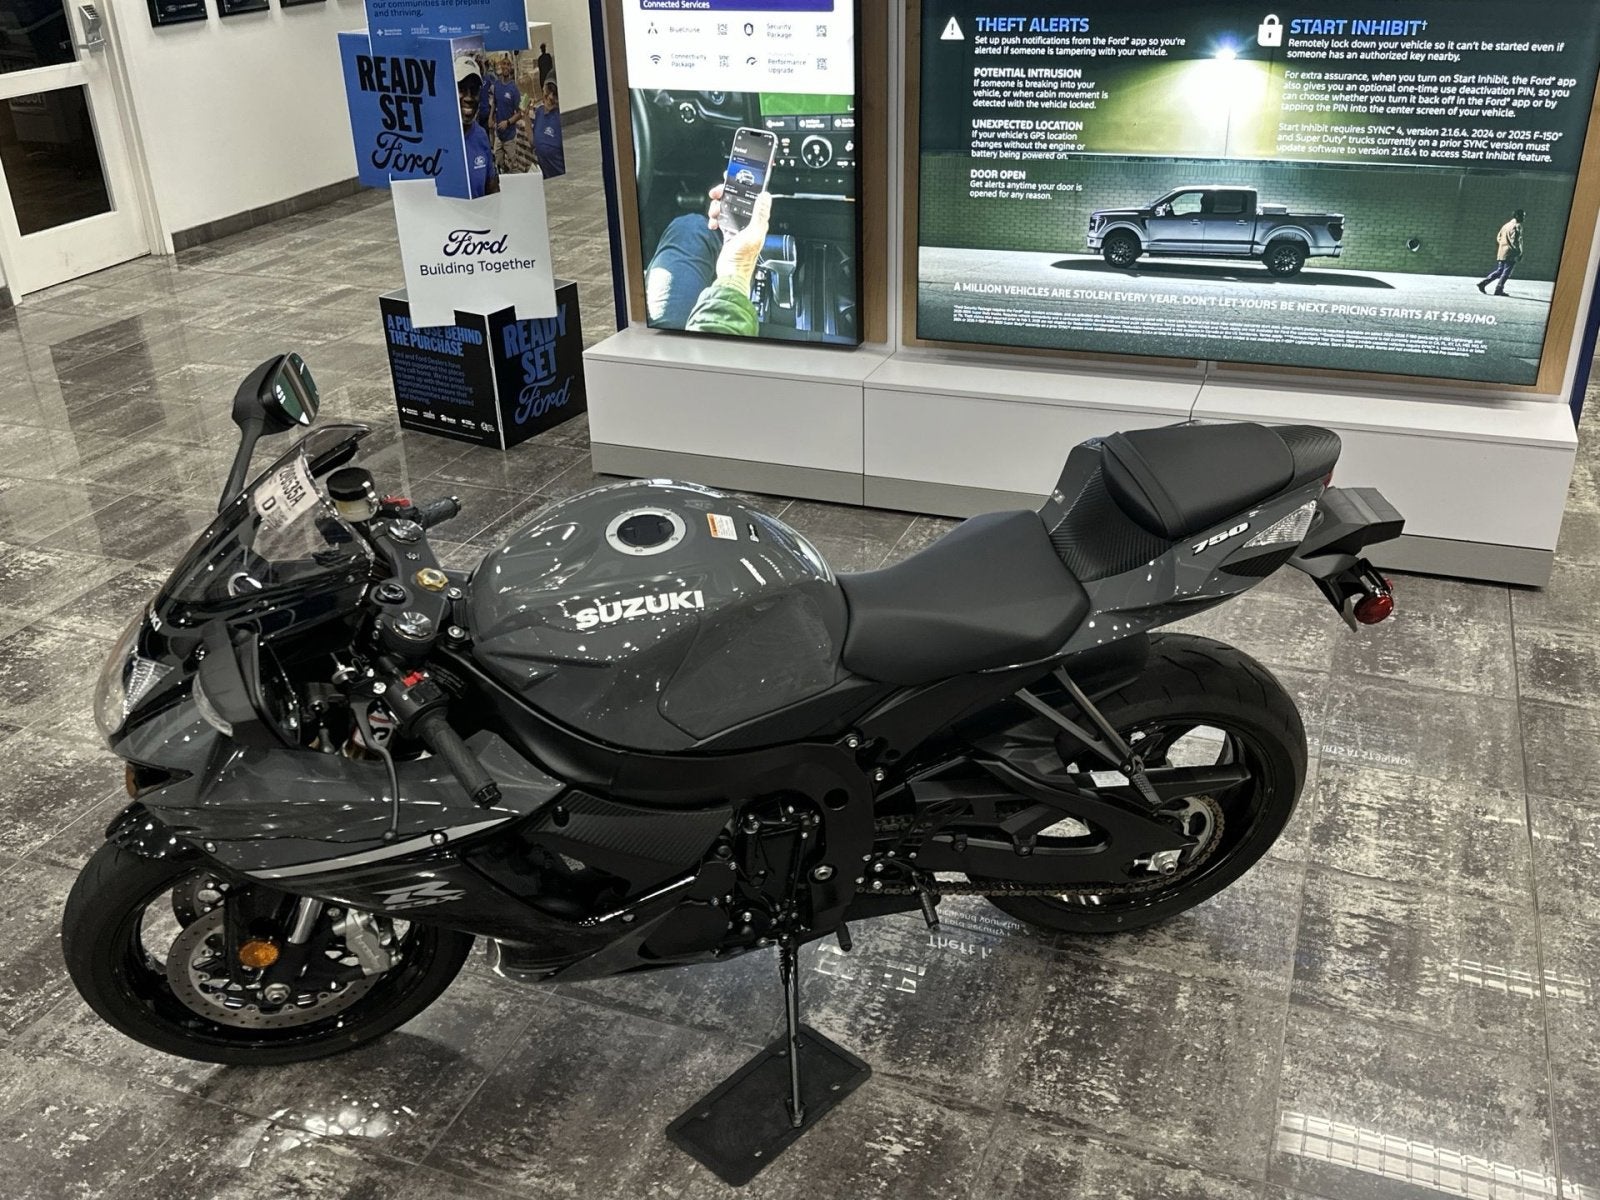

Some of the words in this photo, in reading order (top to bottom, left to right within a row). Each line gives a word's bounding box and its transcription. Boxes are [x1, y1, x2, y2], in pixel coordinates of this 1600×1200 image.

[642, 0, 680, 8] Connected
[681, 0, 711, 9] Services
[374, 9, 389, 17] and
[390, 8, 423, 17] thriving.
[975, 17, 1026, 32] THEFT
[1028, 18, 1089, 33] ALERTS
[1290, 19, 1347, 35] START
[974, 36, 987, 45] Set
[988, 38, 1000, 46] up
[1000, 36, 1021, 47] push
[1022, 36, 1070, 45] notifications
[1071, 36, 1091, 45] from
[1092, 37, 1106, 45] the
[1130, 39, 1147, 47] app
[1288, 38, 1330, 50] Remotely
[1330, 39, 1350, 48] lock
[1351, 39, 1377, 49] down
[1377, 42, 1398, 51] your
[1400, 40, 1433, 50] vehicle
[1447, 41, 1455, 50] it
[1481, 41, 1494, 51] be
[1495, 42, 1530, 51] started
[1531, 44, 1555, 52] even
[1556, 43, 1564, 52] if
[974, 45, 1002, 54] alerted
[1002, 46, 1009, 54] if
[1046, 46, 1054, 55] is
[1055, 46, 1096, 57] tampering
[1097, 47, 1116, 55] with
[1117, 49, 1136, 58] your
[1137, 47, 1168, 56] vehicle.
[1287, 51, 1327, 59] someone
[1328, 50, 1345, 59] has
[1359, 51, 1408, 60] authorized
[1409, 51, 1426, 62] key
[1427, 52, 1461, 63] nearby.
[356, 55, 436, 97] READY
[973, 68, 1026, 78] POTENTIAL
[1027, 69, 1082, 79] INTRUSION
[1285, 70, 1299, 79] For
[1300, 70, 1323, 80] extra
[1324, 73, 1370, 83] assurance,
[1371, 72, 1397, 82] when
[1397, 75, 1416, 84] you
[1417, 73, 1438, 82] turn
[1453, 74, 1476, 83] Start
[1477, 74, 1510, 86] Inhibit,
[1511, 75, 1529, 85] the
[1557, 78, 1577, 88] app
[973, 78, 979, 87] If
[1016, 79, 1023, 88] is
[1024, 79, 1058, 90] breaking
[1060, 80, 1076, 88] into
[1076, 82, 1095, 91] your
[972, 88, 1001, 99] vehicle,
[1012, 89, 1034, 98] when
[1035, 89, 1056, 98] cabin
[1057, 90, 1100, 99] movement
[1101, 90, 1108, 99] is
[972, 98, 1006, 107] detected
[1006, 99, 1024, 108] with
[1025, 99, 1039, 108] the
[1040, 99, 1067, 108] vehicle
[1068, 100, 1096, 109] locked.
[379, 93, 424, 133] SET
[971, 119, 1034, 130] UNEXPECTED
[1035, 121, 1083, 131] LOCATION
[971, 130, 978, 138] If
[978, 132, 995, 140] your
[1029, 131, 1045, 140] GPS
[1046, 131, 1077, 140] location
[970, 139, 1002, 150] changes
[1003, 140, 1033, 149] without
[1034, 141, 1047, 150] the
[1048, 141, 1075, 152] engine
[970, 149, 997, 160] battery
[998, 150, 1020, 160] being
[1021, 150, 1055, 161] powered
[970, 169, 998, 179] DOOR
[999, 170, 1026, 180] OPEN
[969, 180, 983, 188] Get
[984, 180, 1005, 189] alerts
[1006, 181, 1036, 192] anytime
[1037, 183, 1055, 192] your
[1056, 182, 1074, 190] door
[1075, 182, 1082, 191] is
[443, 229, 508, 257] Ford
[420, 262, 475, 276] Building
[477, 258, 536, 273] Together
[953, 280, 960, 292] A
[962, 281, 1002, 294] MILLION
[1003, 283, 1049, 297] VEHICLES
[1050, 286, 1071, 298] ARE
[1072, 288, 1112, 301] STOLEN
[1114, 290, 1148, 303] EVERY
[1149, 292, 1179, 305] YEAR.
[1218, 297, 1238, 309] LET
[1239, 298, 1278, 311] YOURS
[1279, 300, 1295, 312] BE
[1296, 302, 1328, 314] NEXT.
[1330, 304, 1377, 318] PRICING
[1379, 307, 1422, 320] STARTS
[1423, 309, 1440, 322] AT
[1440, 310, 1497, 325] $7.99/MO.
[444, 325, 483, 346] BEHIND
[388, 329, 410, 347] THE
[409, 333, 464, 357] PURCHASE
[521, 341, 557, 385] SET
[262, 496, 277, 511] D
[1192, 522, 1249, 555] 750
[575, 590, 705, 631] SUZUKI
